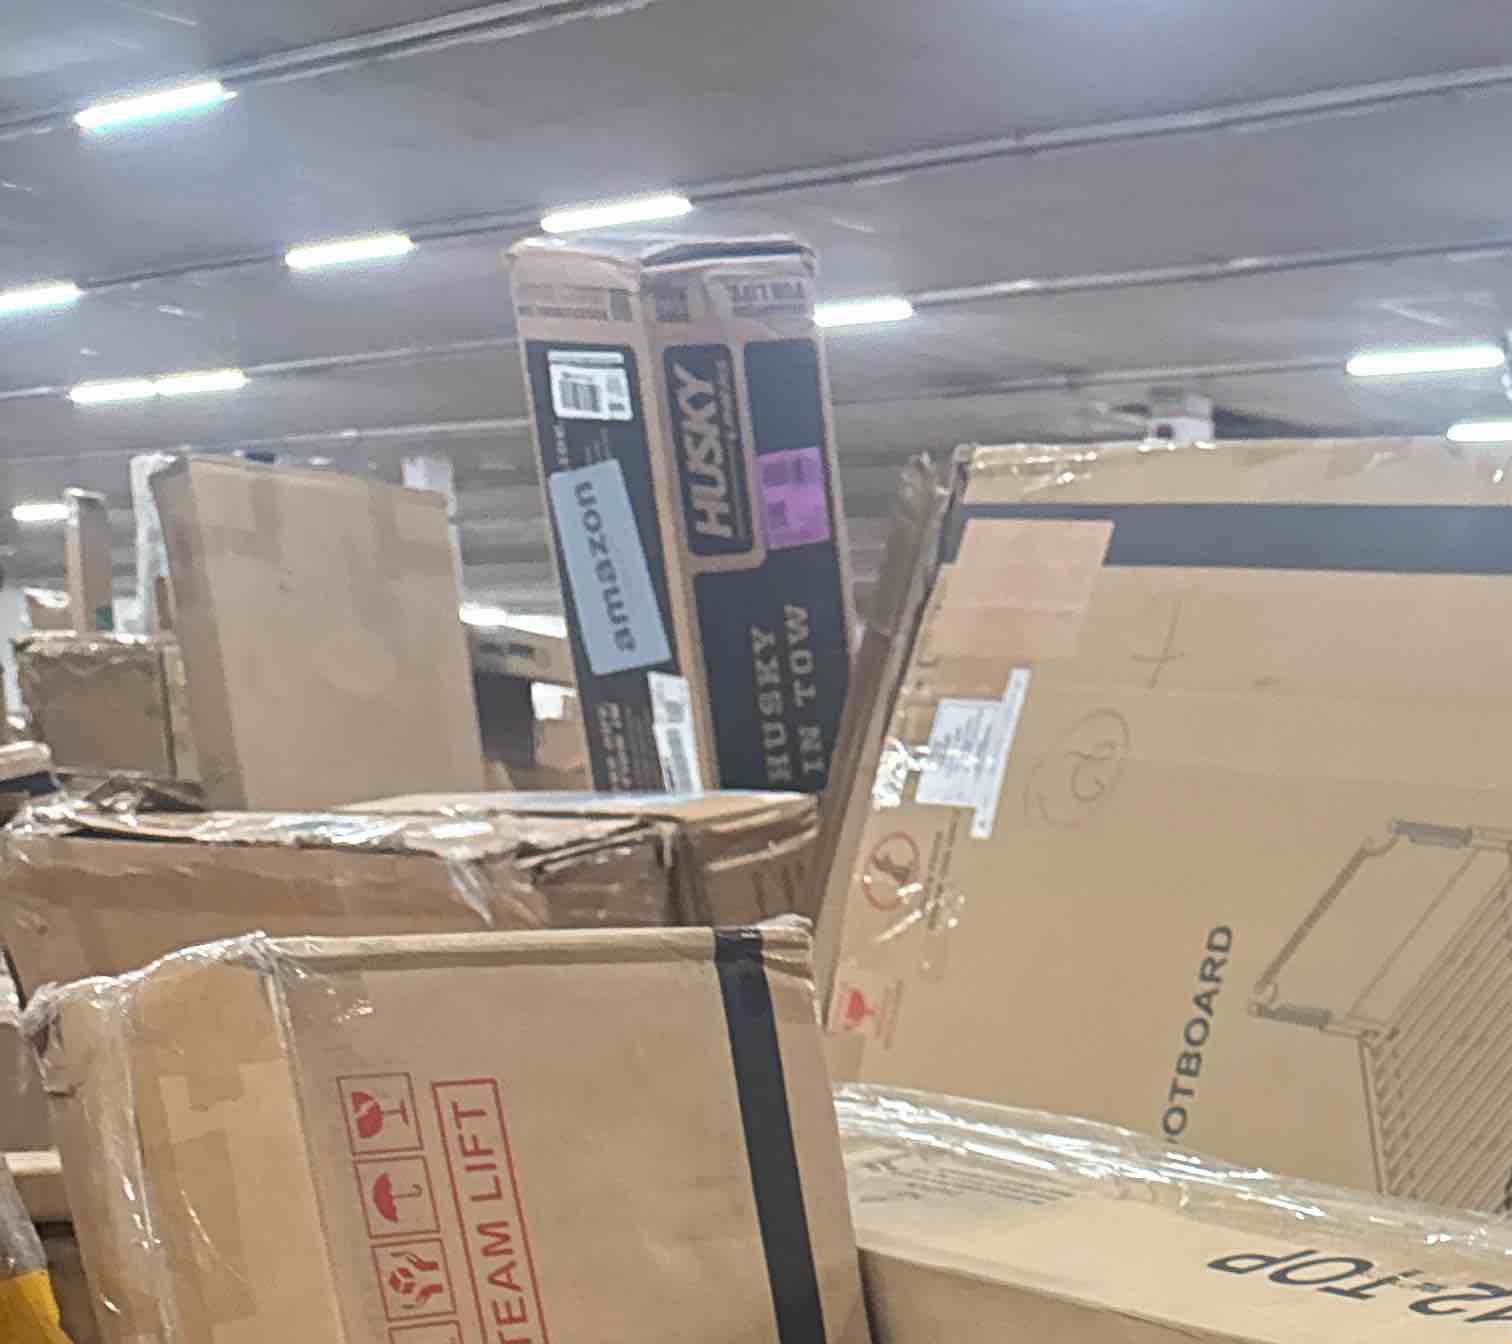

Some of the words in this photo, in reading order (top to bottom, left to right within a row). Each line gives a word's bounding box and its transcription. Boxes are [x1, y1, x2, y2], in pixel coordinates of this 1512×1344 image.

[672, 361, 735, 539] HUSKY
[575, 479, 637, 653] amazon
[752, 625, 791, 782] HUSKY
[784, 602, 816, 707] TOW
[797, 724, 824, 776] IN
[1163, 925, 1233, 1143] OTBOARD
[452, 1101, 502, 1203] LIFT
